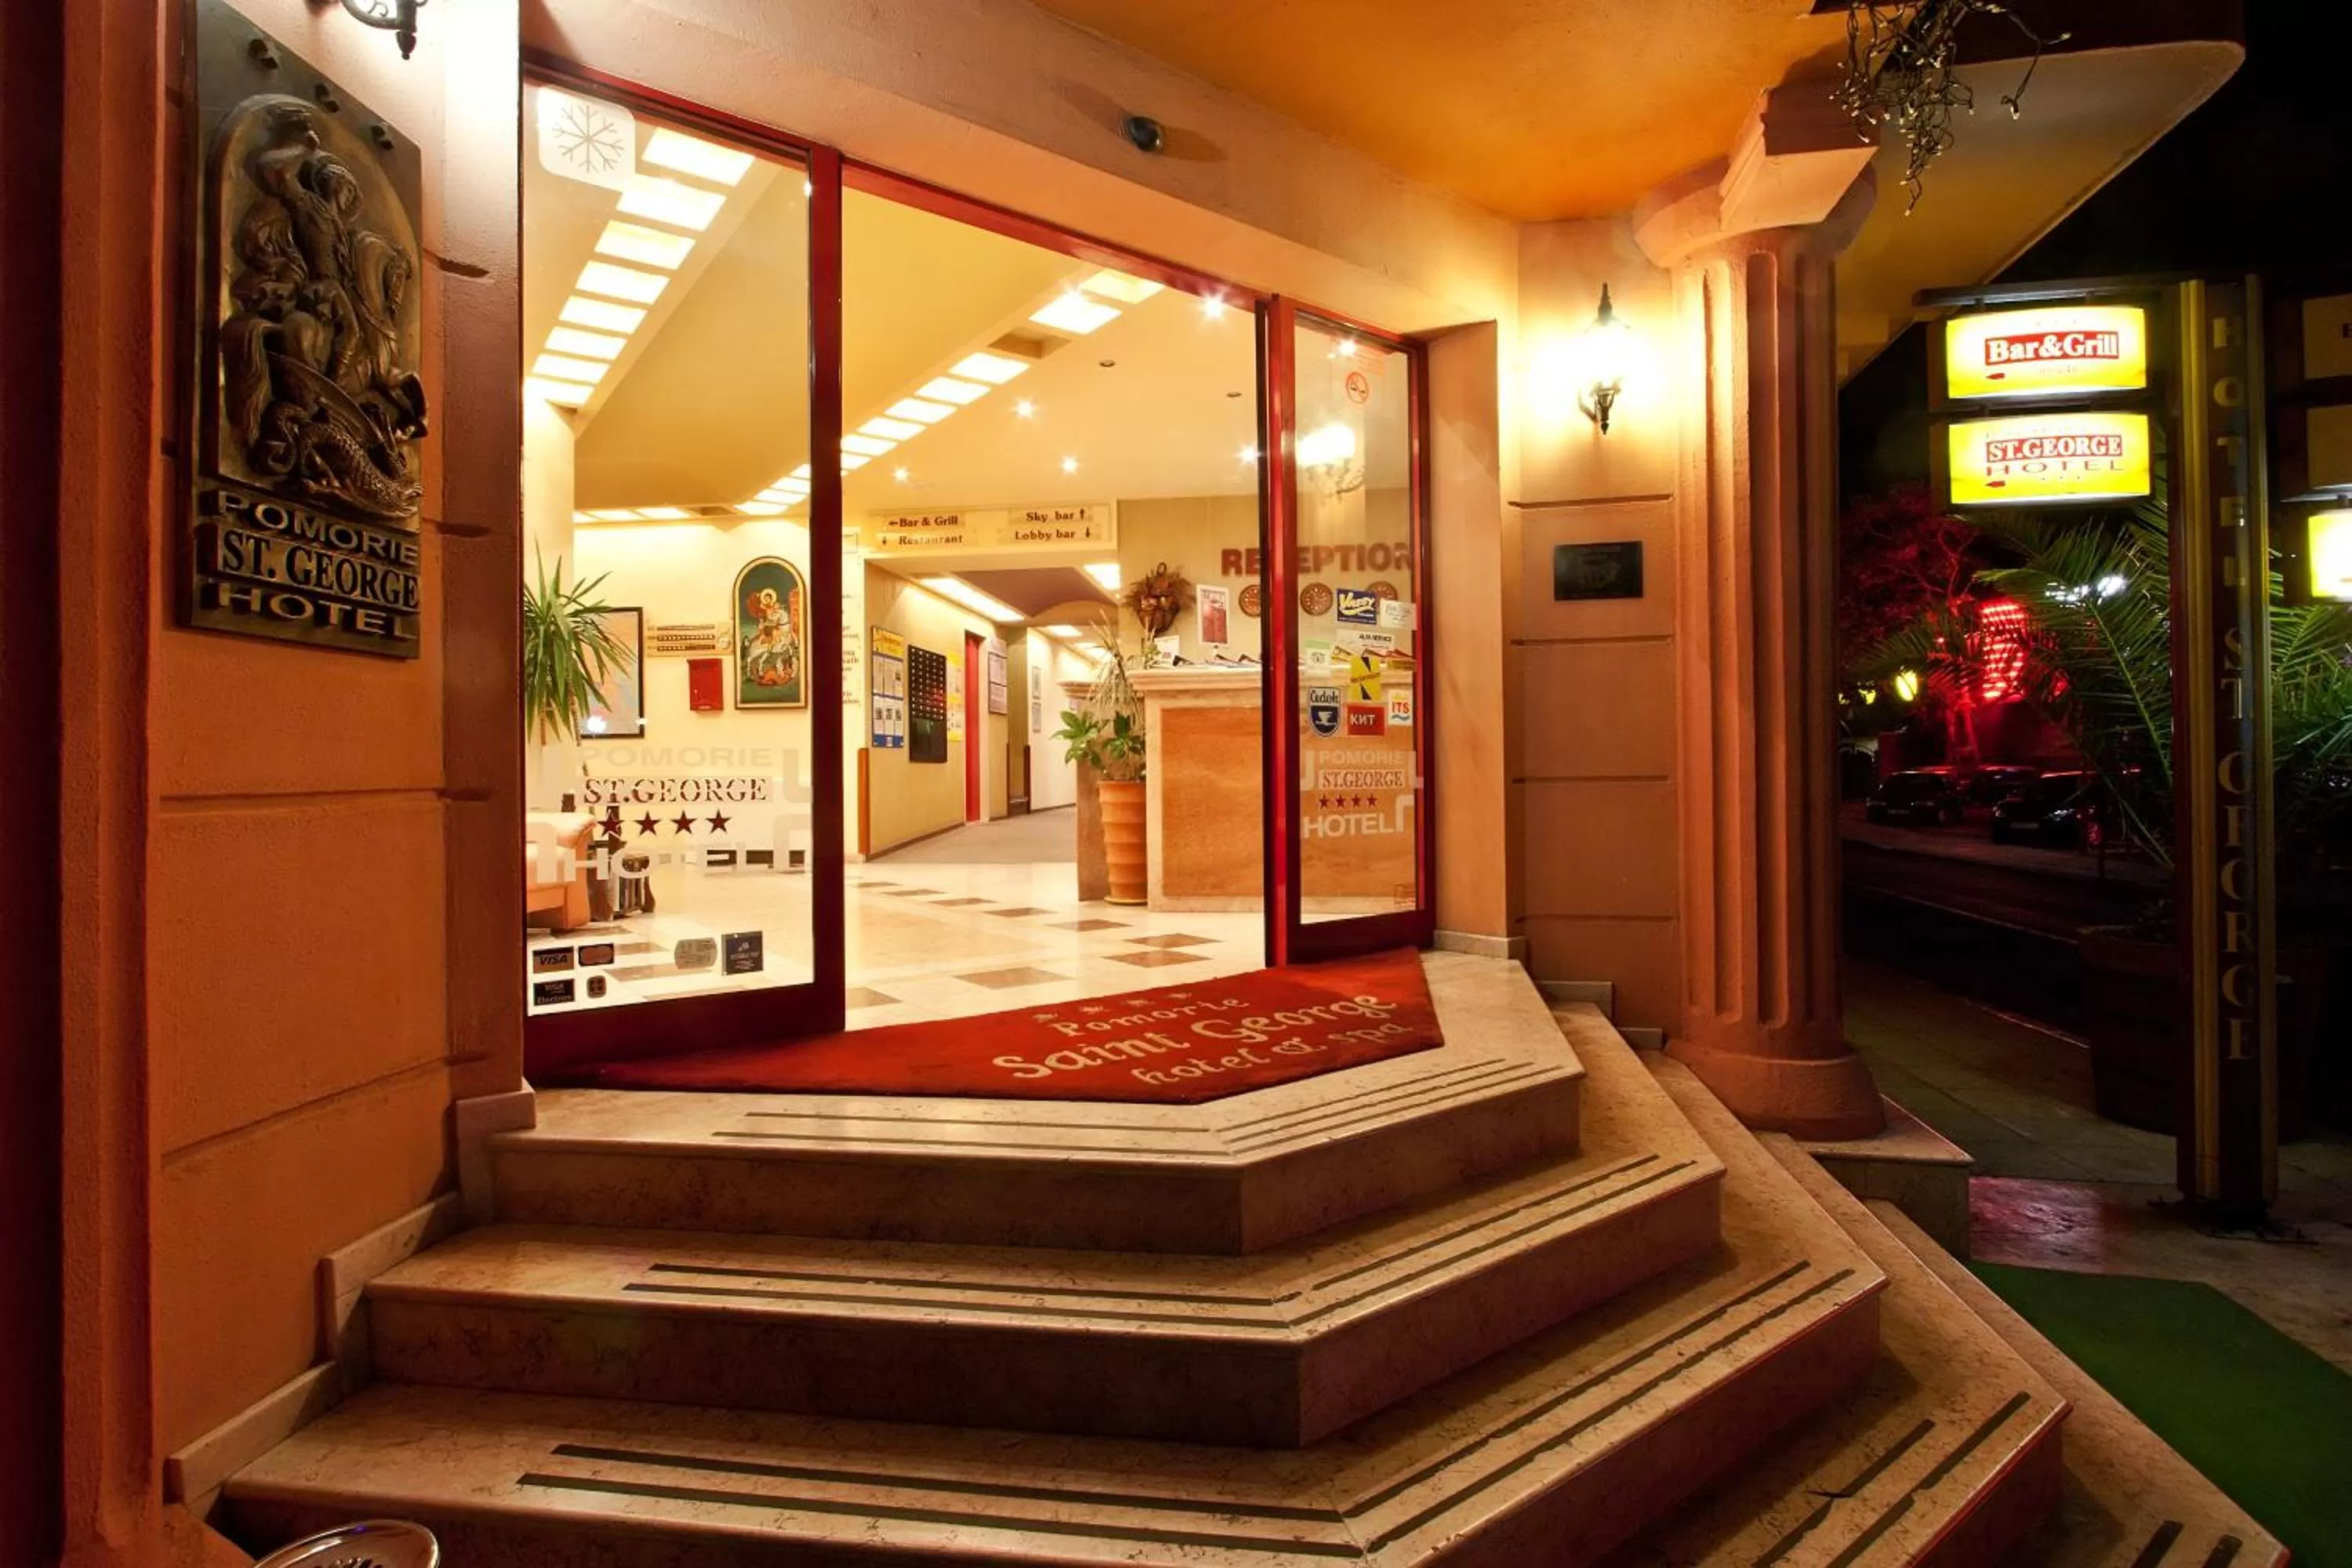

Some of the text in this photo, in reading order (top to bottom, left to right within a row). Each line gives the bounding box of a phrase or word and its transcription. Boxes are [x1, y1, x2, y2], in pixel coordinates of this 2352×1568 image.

[1987, 332, 2118, 362] Bar&Grill
[1988, 436, 2122, 461] ST.GEORGE
[1986, 459, 2124, 476] HOTEL
[218, 490, 419, 565] POMORIE
[899, 515, 958, 528] Bar & Grill
[1025, 510, 1074, 523] Sky bar
[1015, 528, 1075, 541] Lobby bar
[1221, 542, 1413, 576] REEPTION
[218, 583, 417, 640] HOTEL
[1392, 702, 1410, 713] ITS
[579, 746, 773, 768] POMORIE
[1319, 750, 1405, 764] POMORIE
[1304, 812, 1394, 838] HOTEL
[539, 953, 568, 966] VISA
[993, 993, 1396, 1079] Saint George
[1130, 1045, 1270, 1085] hotel
